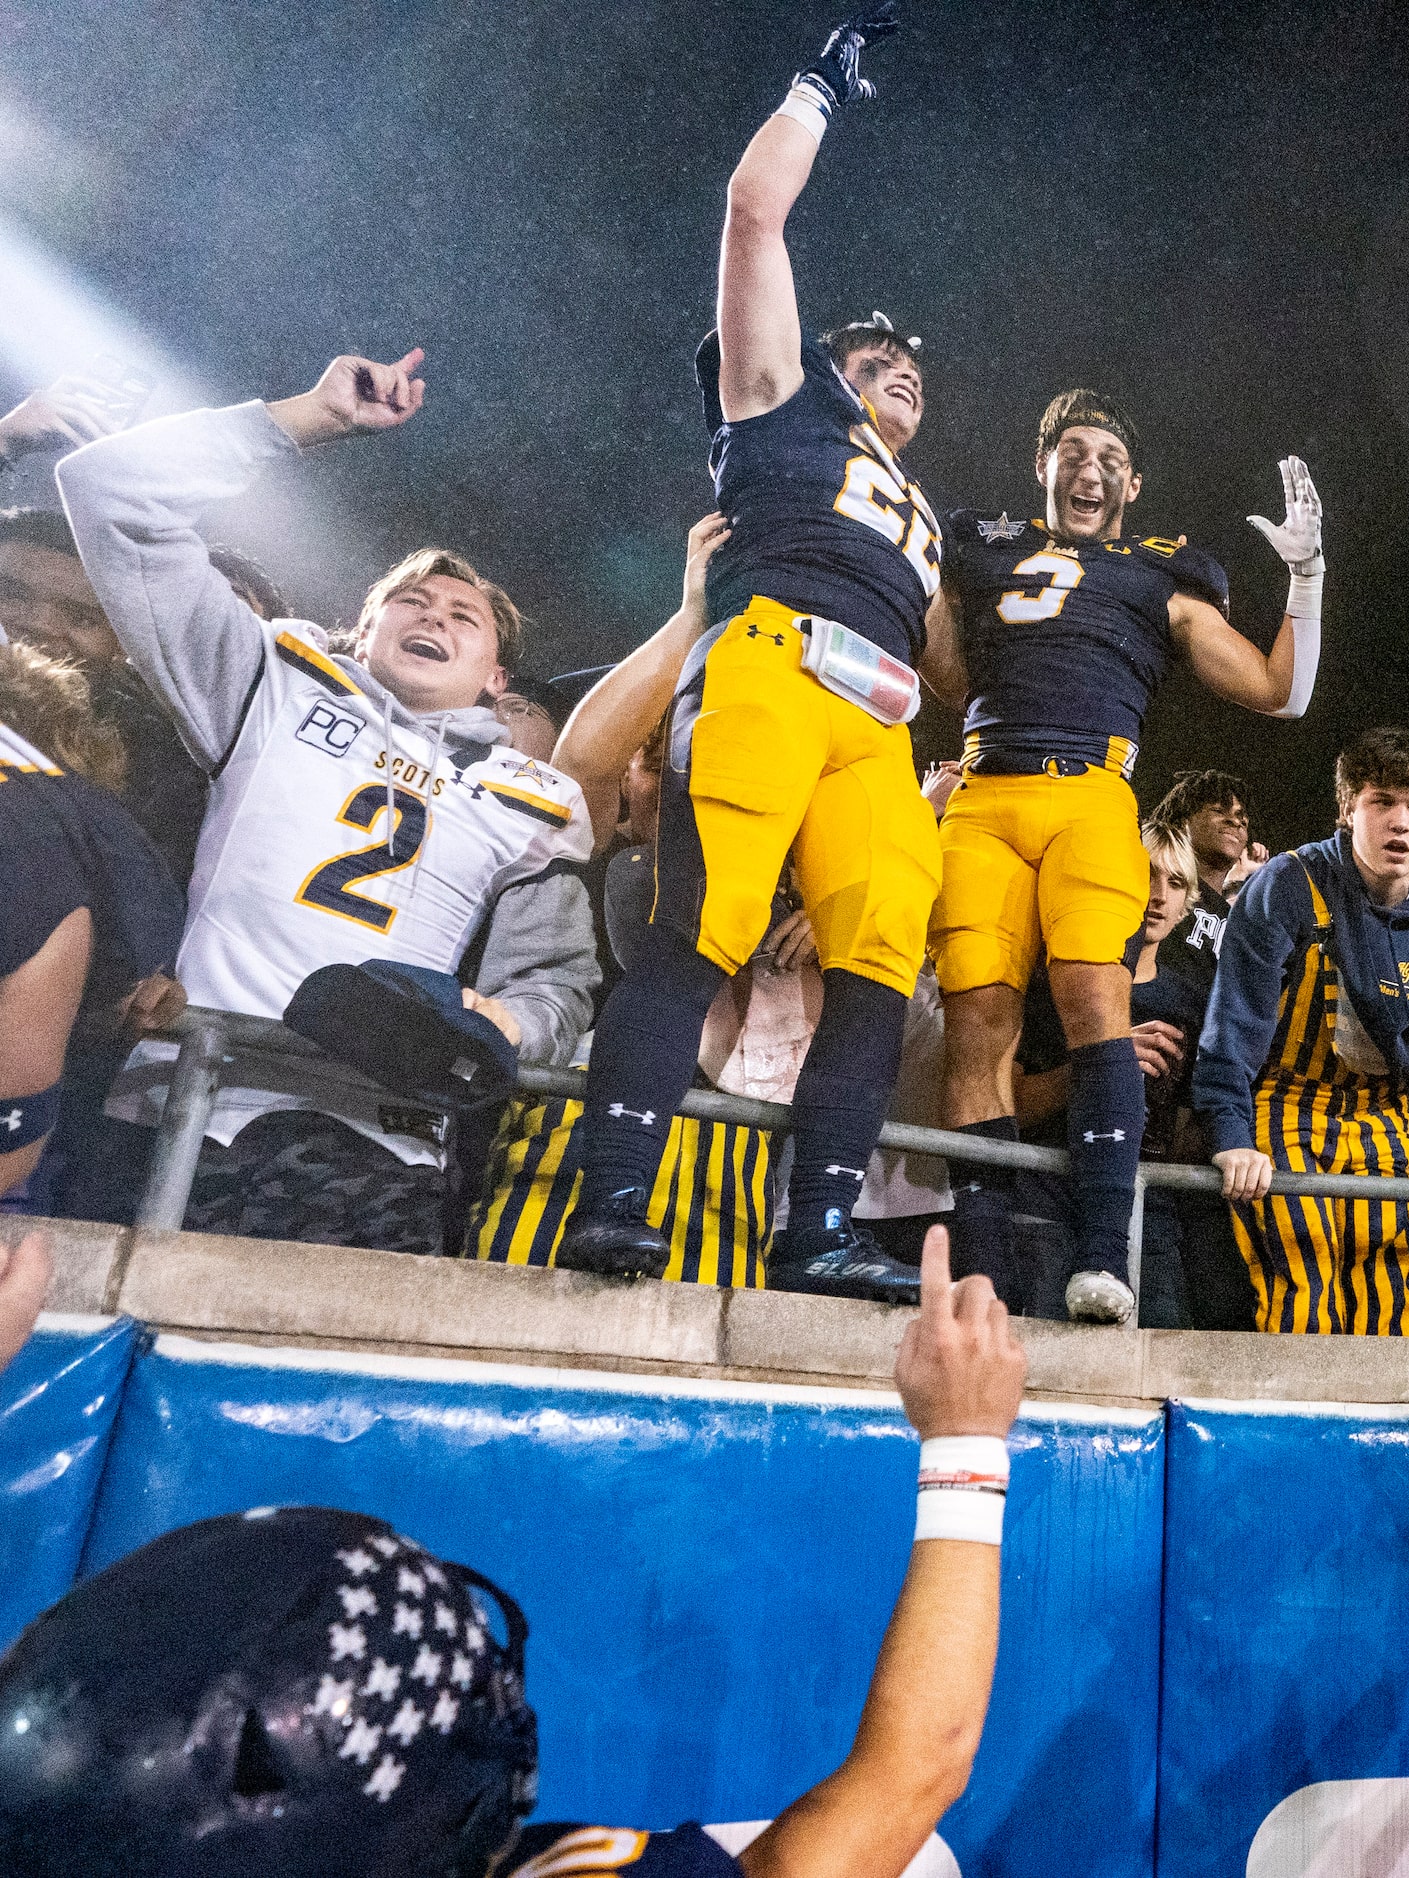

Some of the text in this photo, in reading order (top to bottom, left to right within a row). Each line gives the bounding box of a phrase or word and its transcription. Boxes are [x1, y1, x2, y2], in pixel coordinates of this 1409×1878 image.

[996, 550, 1086, 624] 3
[300, 704, 361, 751] PC
[374, 751, 445, 796] SCOTS
[294, 782, 433, 936] 2
[1186, 907, 1227, 960] P
